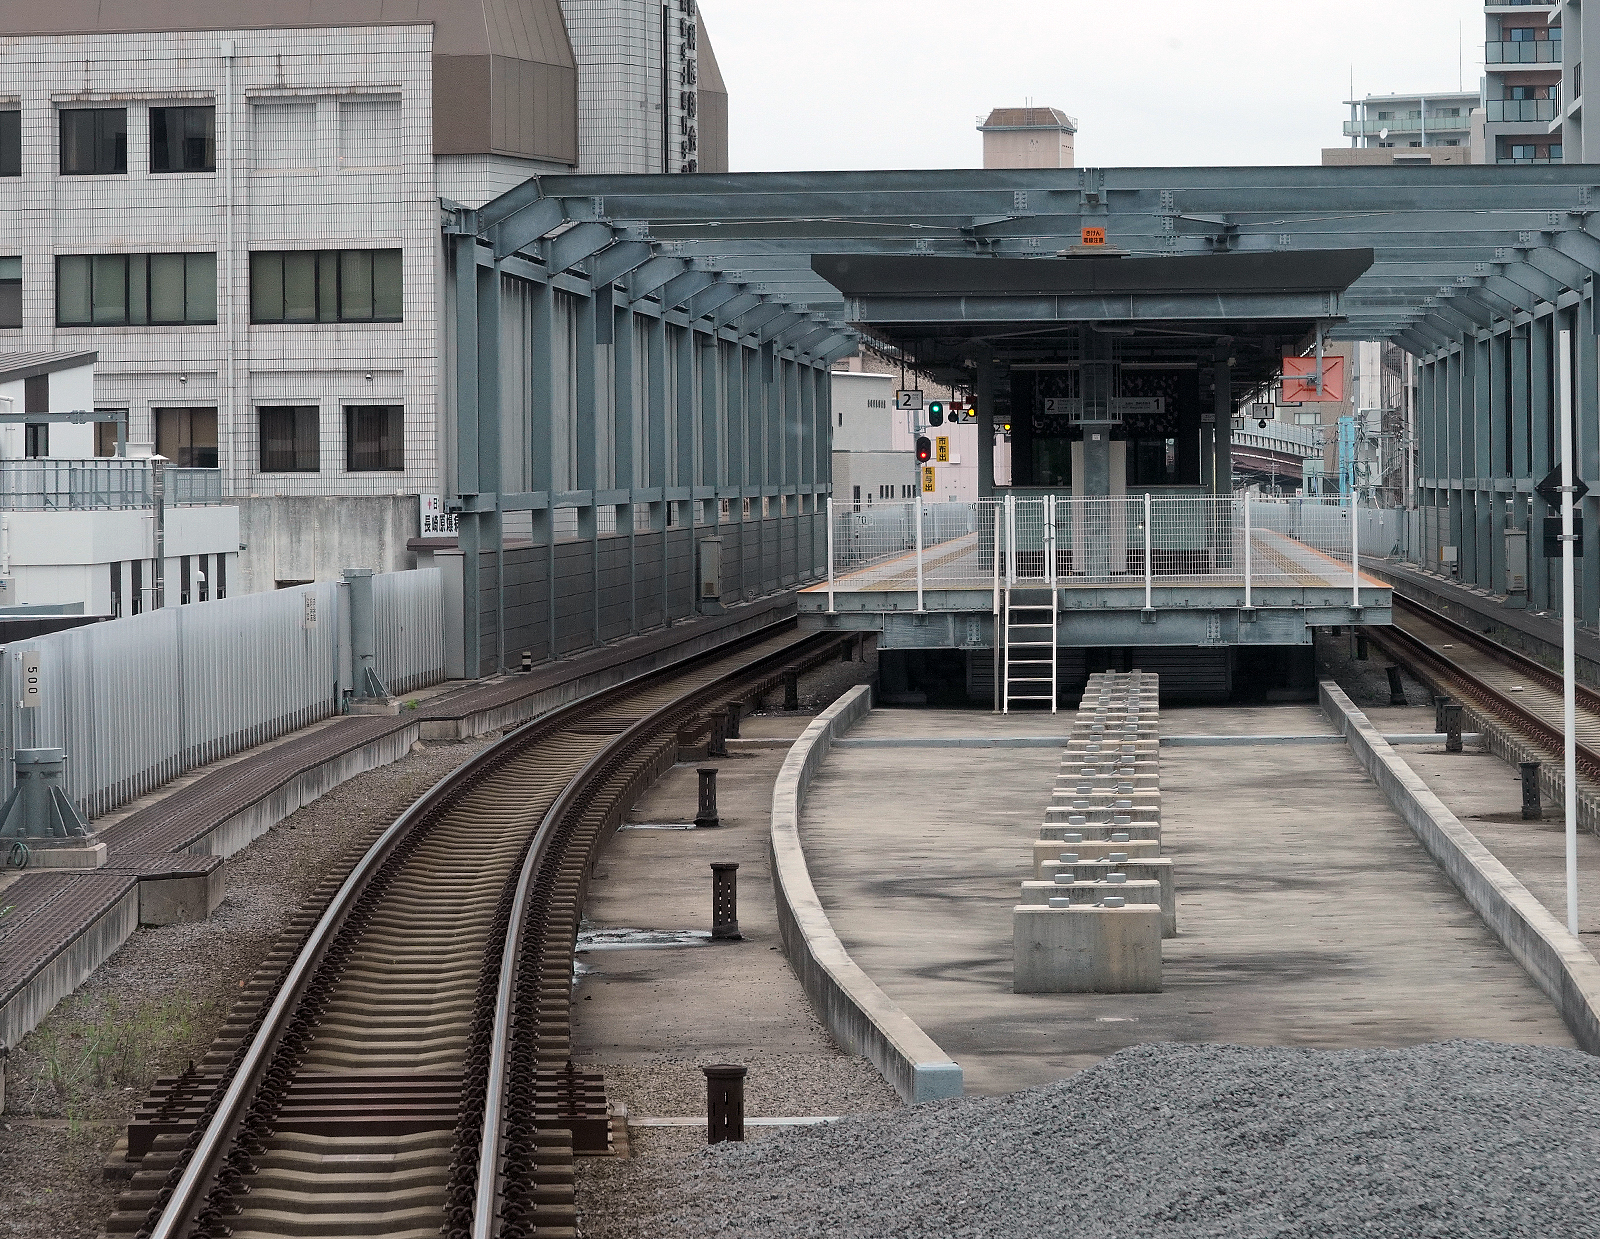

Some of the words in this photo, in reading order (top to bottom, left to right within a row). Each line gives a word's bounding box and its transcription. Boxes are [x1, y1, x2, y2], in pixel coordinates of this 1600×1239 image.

[902, 393, 912, 407] 2
[1046, 399, 1055, 411] 2
[1153, 398, 1161, 410] 1
[961, 411, 969, 422] 2
[1262, 405, 1268, 417] 1
[1234, 419, 1239, 428] 1
[938, 437, 947, 461] 市布出
[924, 467, 933, 491] 長与出
[27, 666, 38, 694] 500
